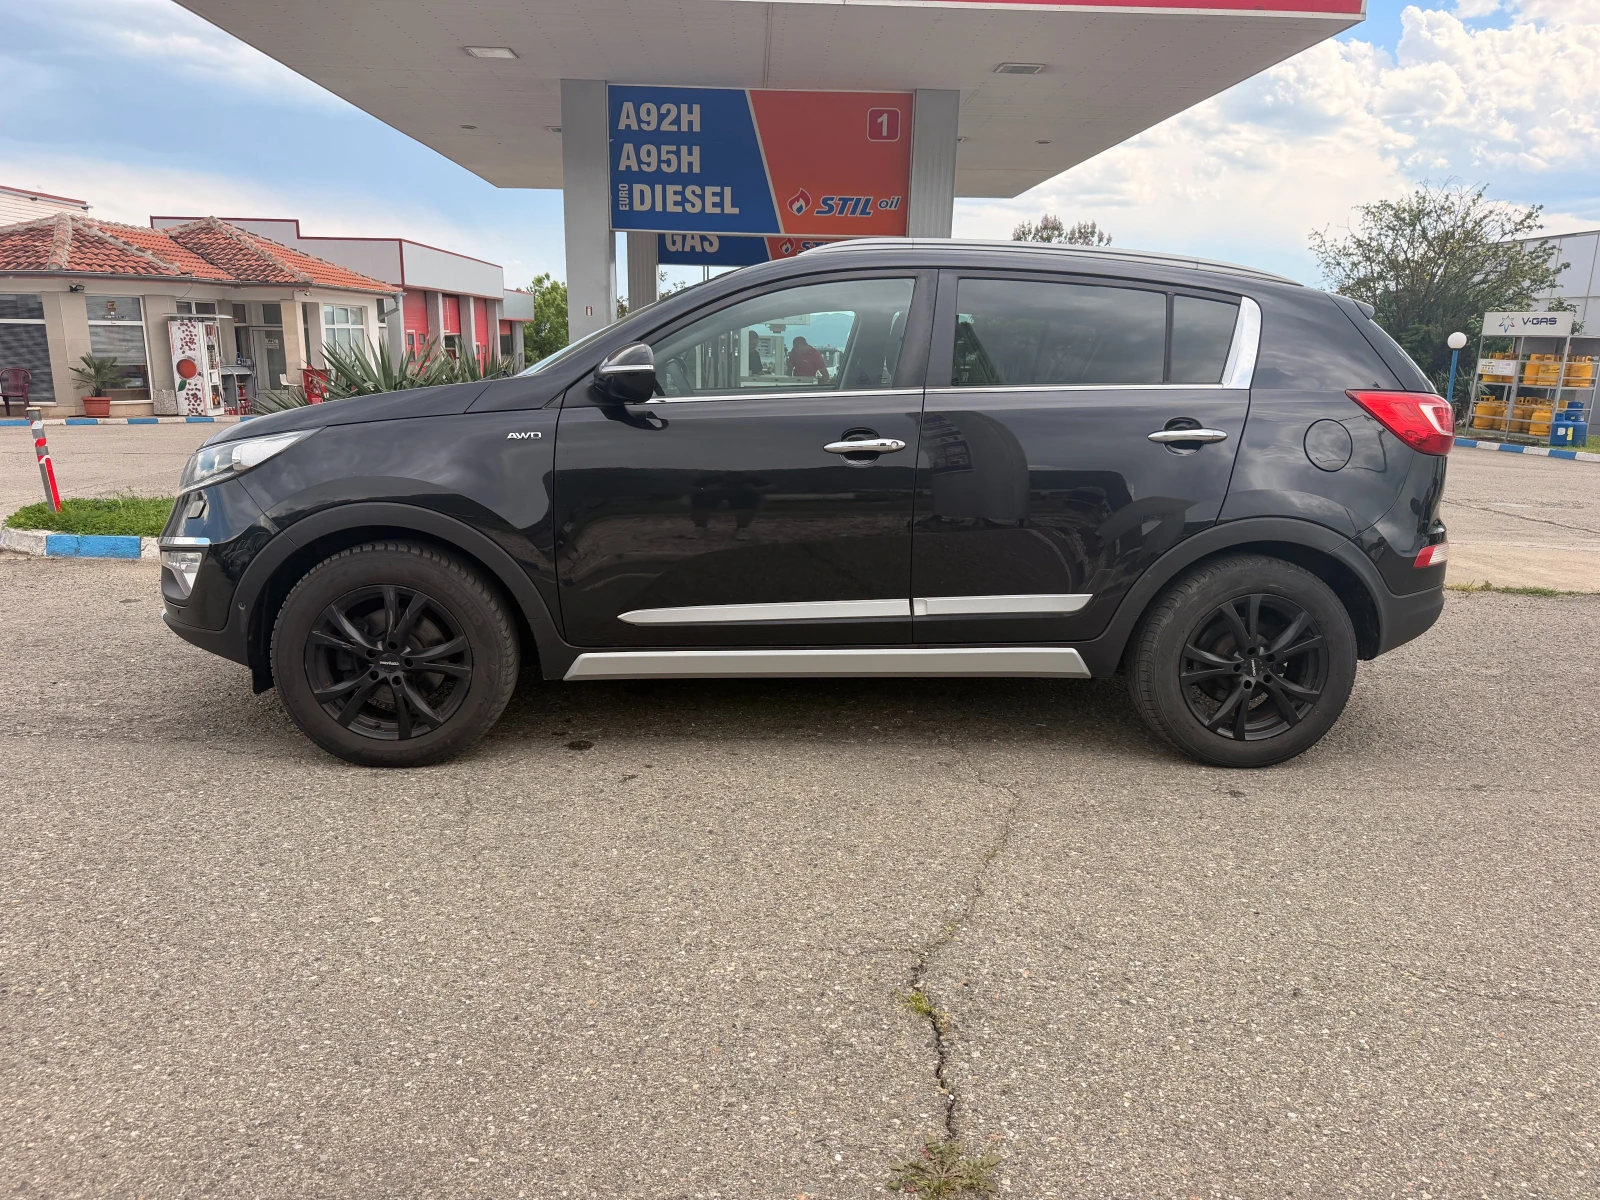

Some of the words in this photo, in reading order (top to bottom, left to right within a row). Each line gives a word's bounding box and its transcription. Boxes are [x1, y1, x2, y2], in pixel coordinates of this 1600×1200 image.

[617, 101, 701, 132] A92H
[877, 113, 888, 136] 1
[618, 143, 701, 173] A95H
[618, 183, 629, 211] EURO
[632, 183, 740, 214] DIESEL
[814, 195, 874, 216] STIL
[877, 195, 901, 210] oil
[665, 233, 719, 253] GAS
[506, 431, 542, 440] AWD
